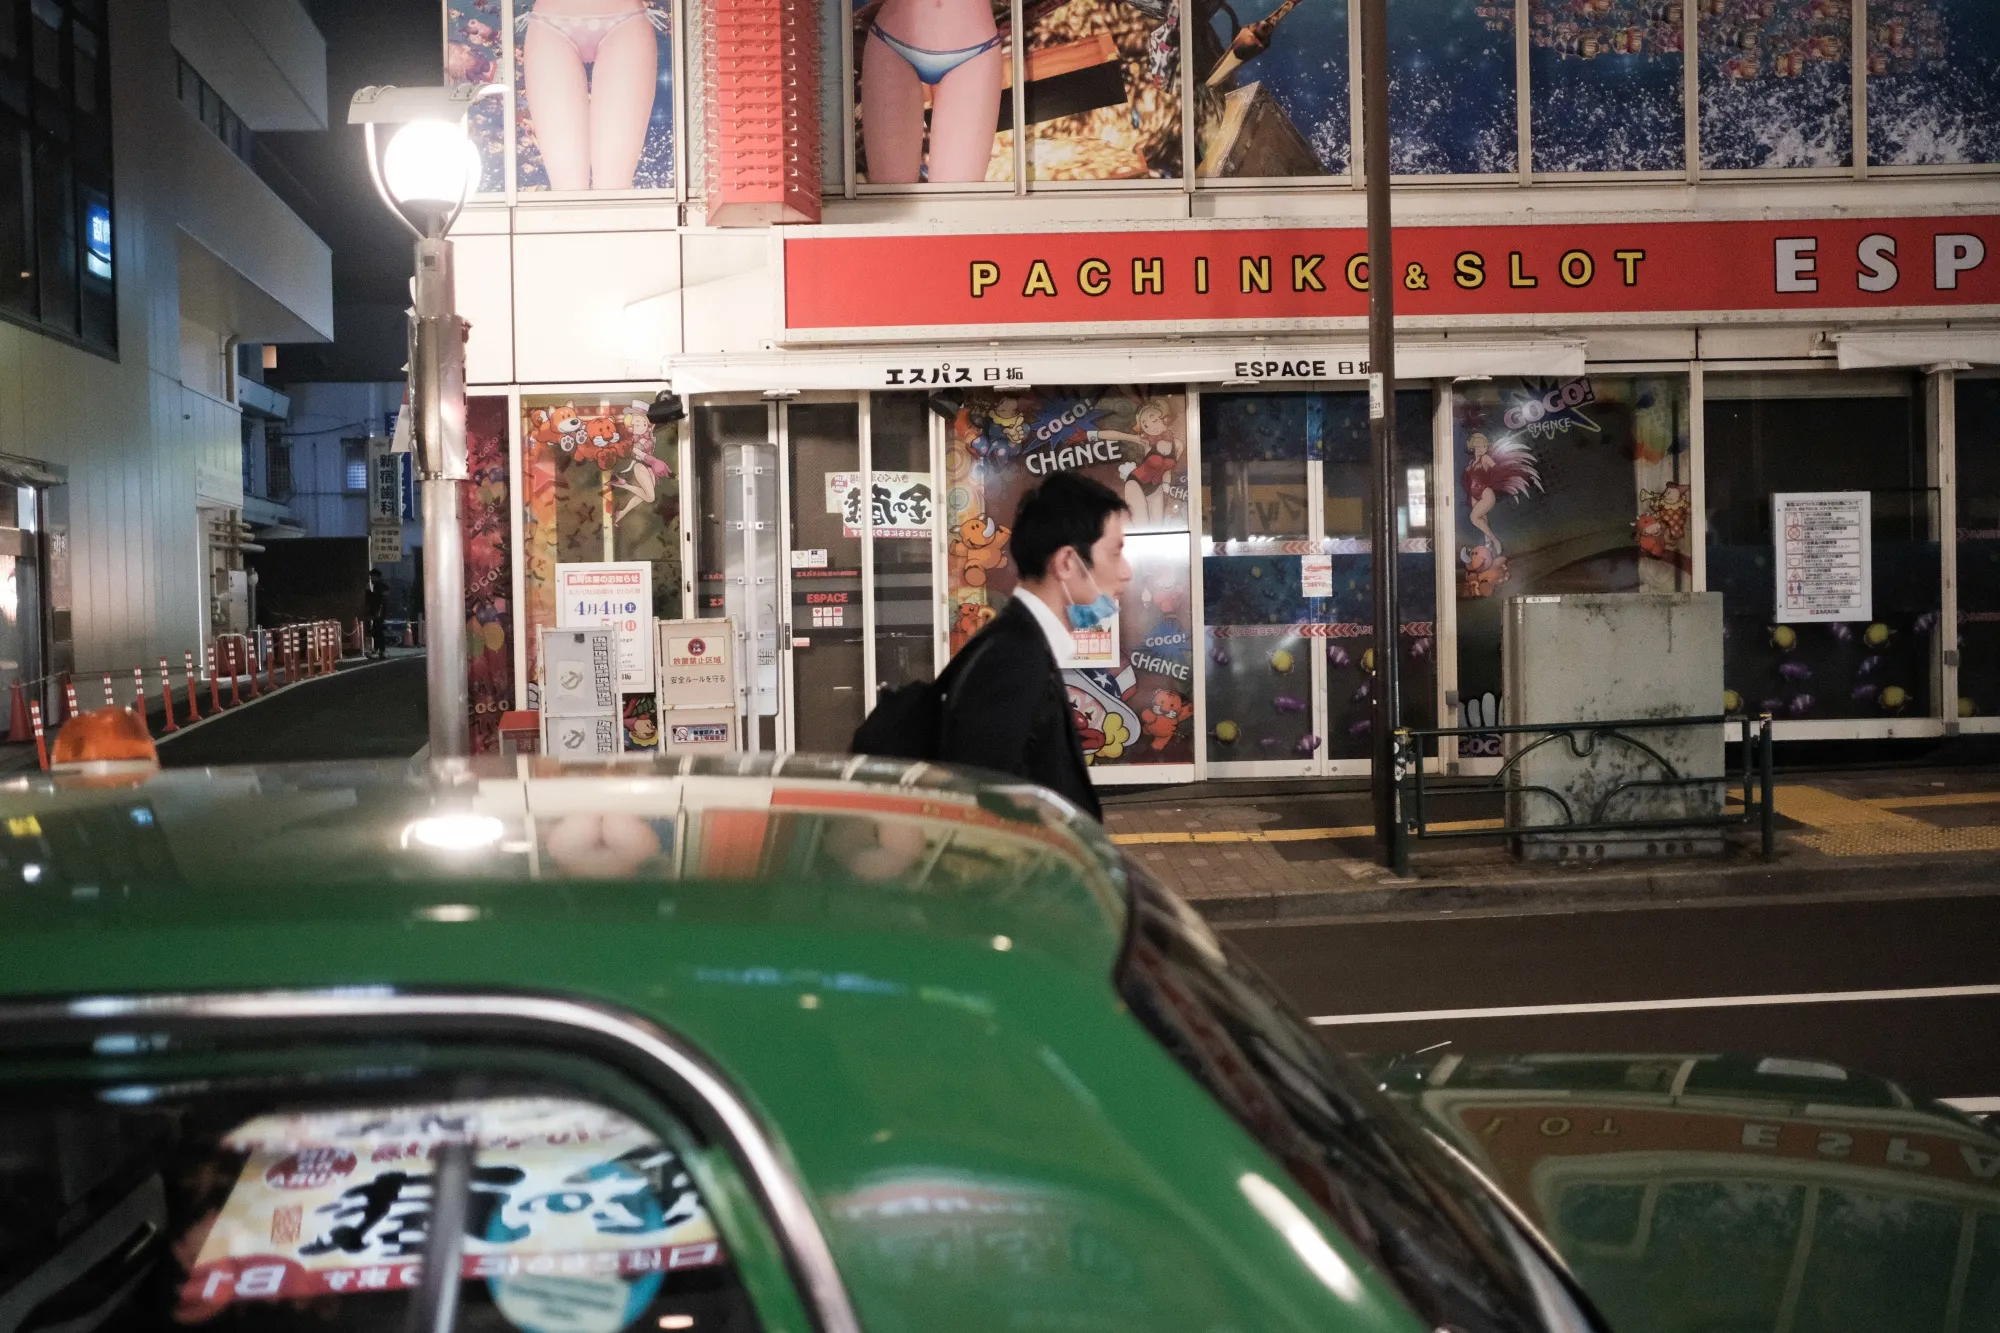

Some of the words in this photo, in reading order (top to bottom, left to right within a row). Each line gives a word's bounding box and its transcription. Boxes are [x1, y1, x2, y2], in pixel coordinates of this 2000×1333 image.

[970, 253, 1369, 298] PACHINKO
[1404, 263, 1430, 290] &
[1453, 248, 1646, 290] SLOT
[1774, 233, 1987, 294] ESP
[885, 363, 973, 385] エスパス
[1235, 360, 1327, 377] ESPACE
[1504, 377, 1594, 430] GOGO!
[1036, 398, 1095, 442] GOGO!
[1527, 418, 1572, 434] CHANCE
[1025, 440, 1122, 475] CHANCE
[379, 454, 395, 515] 新宿歯科
[806, 593, 849, 604] ESPACE
[1145, 633, 1186, 648] GOGO!
[673, 656, 722, 665] 放置禁止区域
[1130, 651, 1190, 681] CHANCE
[670, 674, 726, 685] 安全ルールを守る
